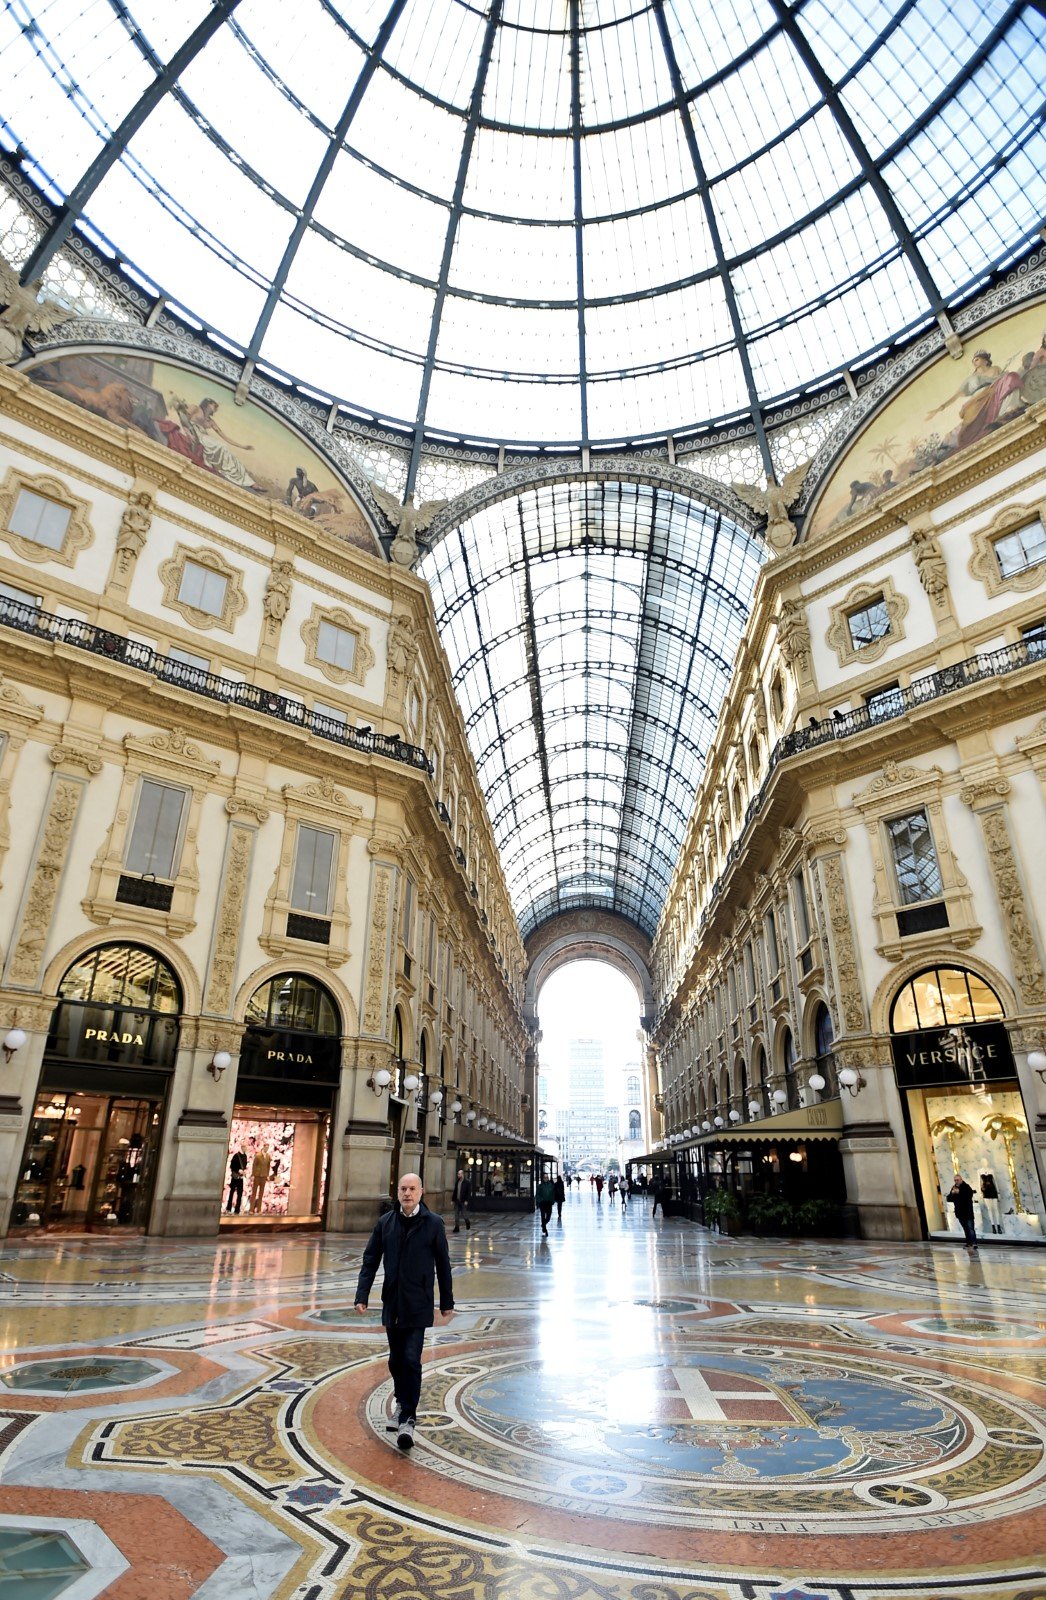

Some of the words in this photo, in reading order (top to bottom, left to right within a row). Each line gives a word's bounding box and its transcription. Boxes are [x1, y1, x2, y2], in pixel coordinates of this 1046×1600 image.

[85, 1028, 143, 1045] PRADA
[267, 1050, 313, 1064] PRADA
[906, 1044, 997, 1066] VERSACE
